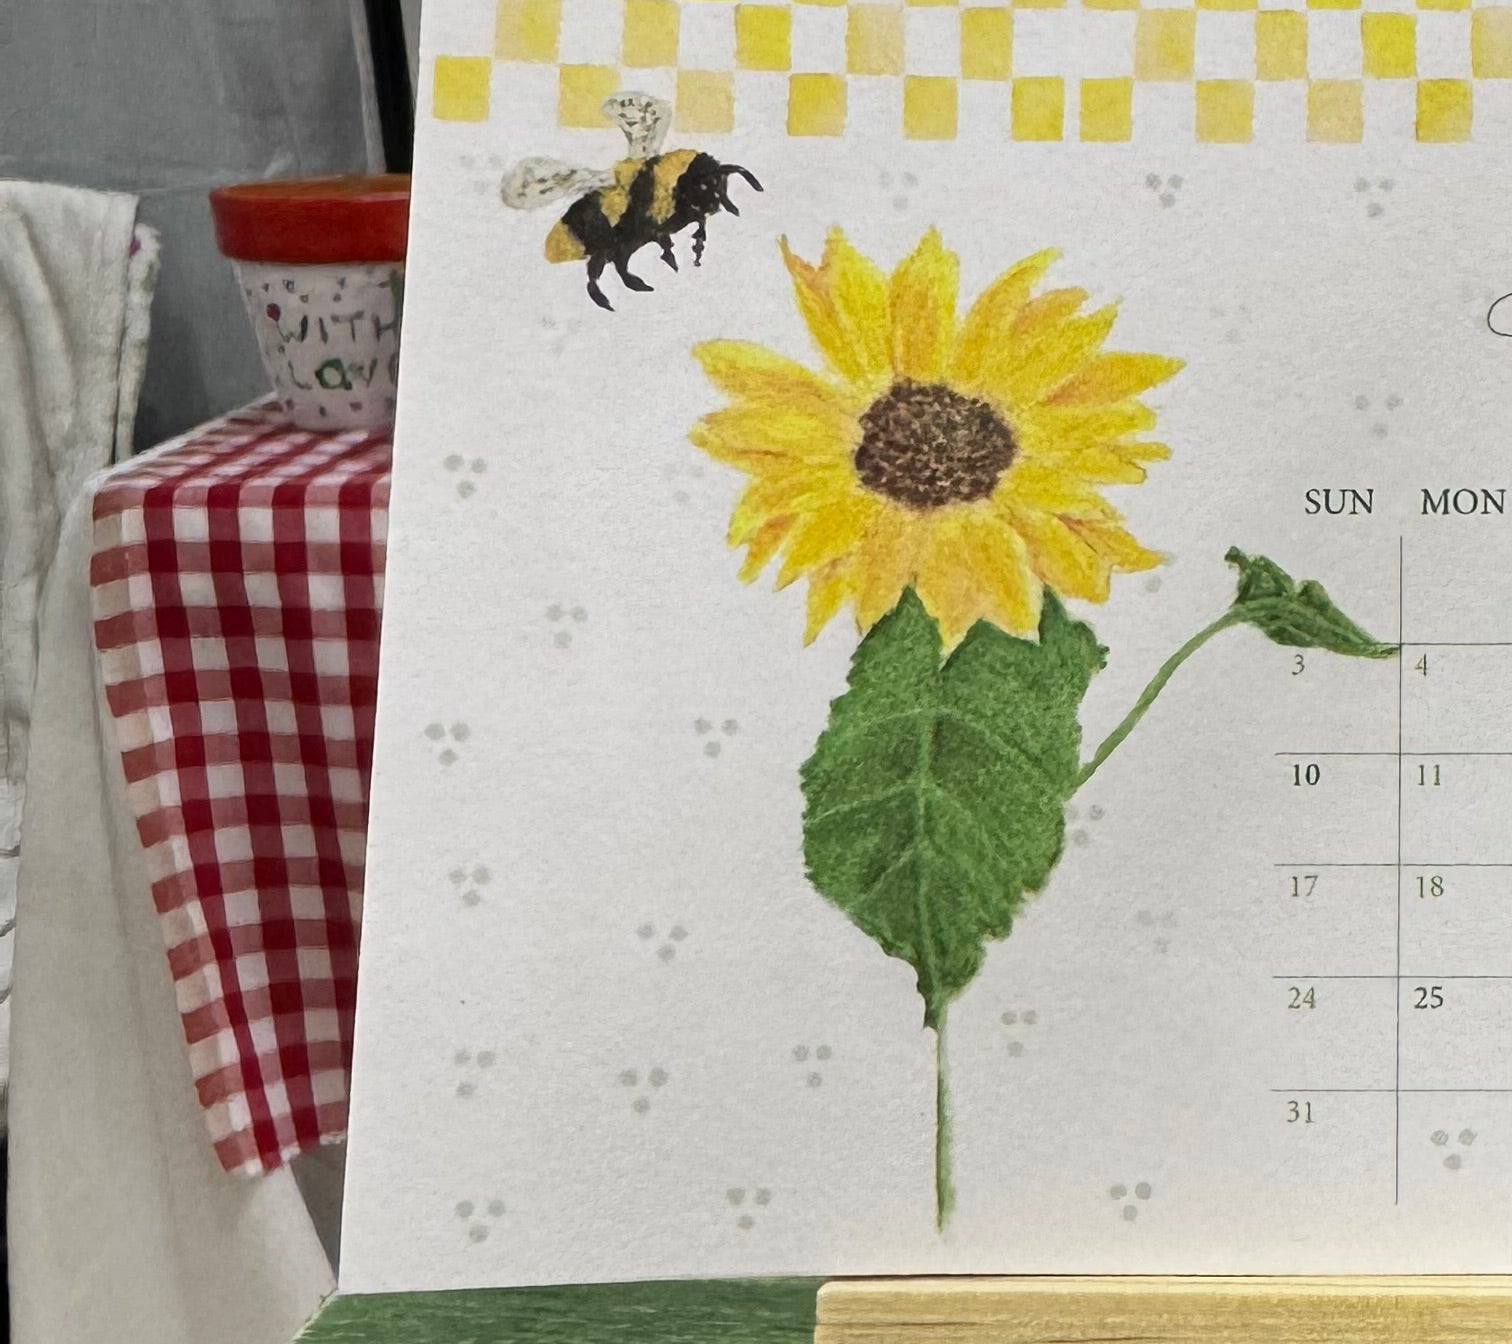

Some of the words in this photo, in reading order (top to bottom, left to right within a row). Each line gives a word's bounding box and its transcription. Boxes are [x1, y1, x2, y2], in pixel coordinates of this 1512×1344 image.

[1305, 489, 1373, 514] SUN
[1421, 489, 1506, 515] MON
[1291, 653, 1306, 676] 3
[1415, 653, 1428, 677] 4
[1293, 763, 1321, 787] 10
[1418, 764, 1441, 786] 11
[1291, 875, 1319, 898] 17
[1416, 875, 1445, 899] 18
[1287, 986, 1316, 1010] 24
[1414, 985, 1444, 1010] 25
[1286, 1100, 1313, 1124] 31
